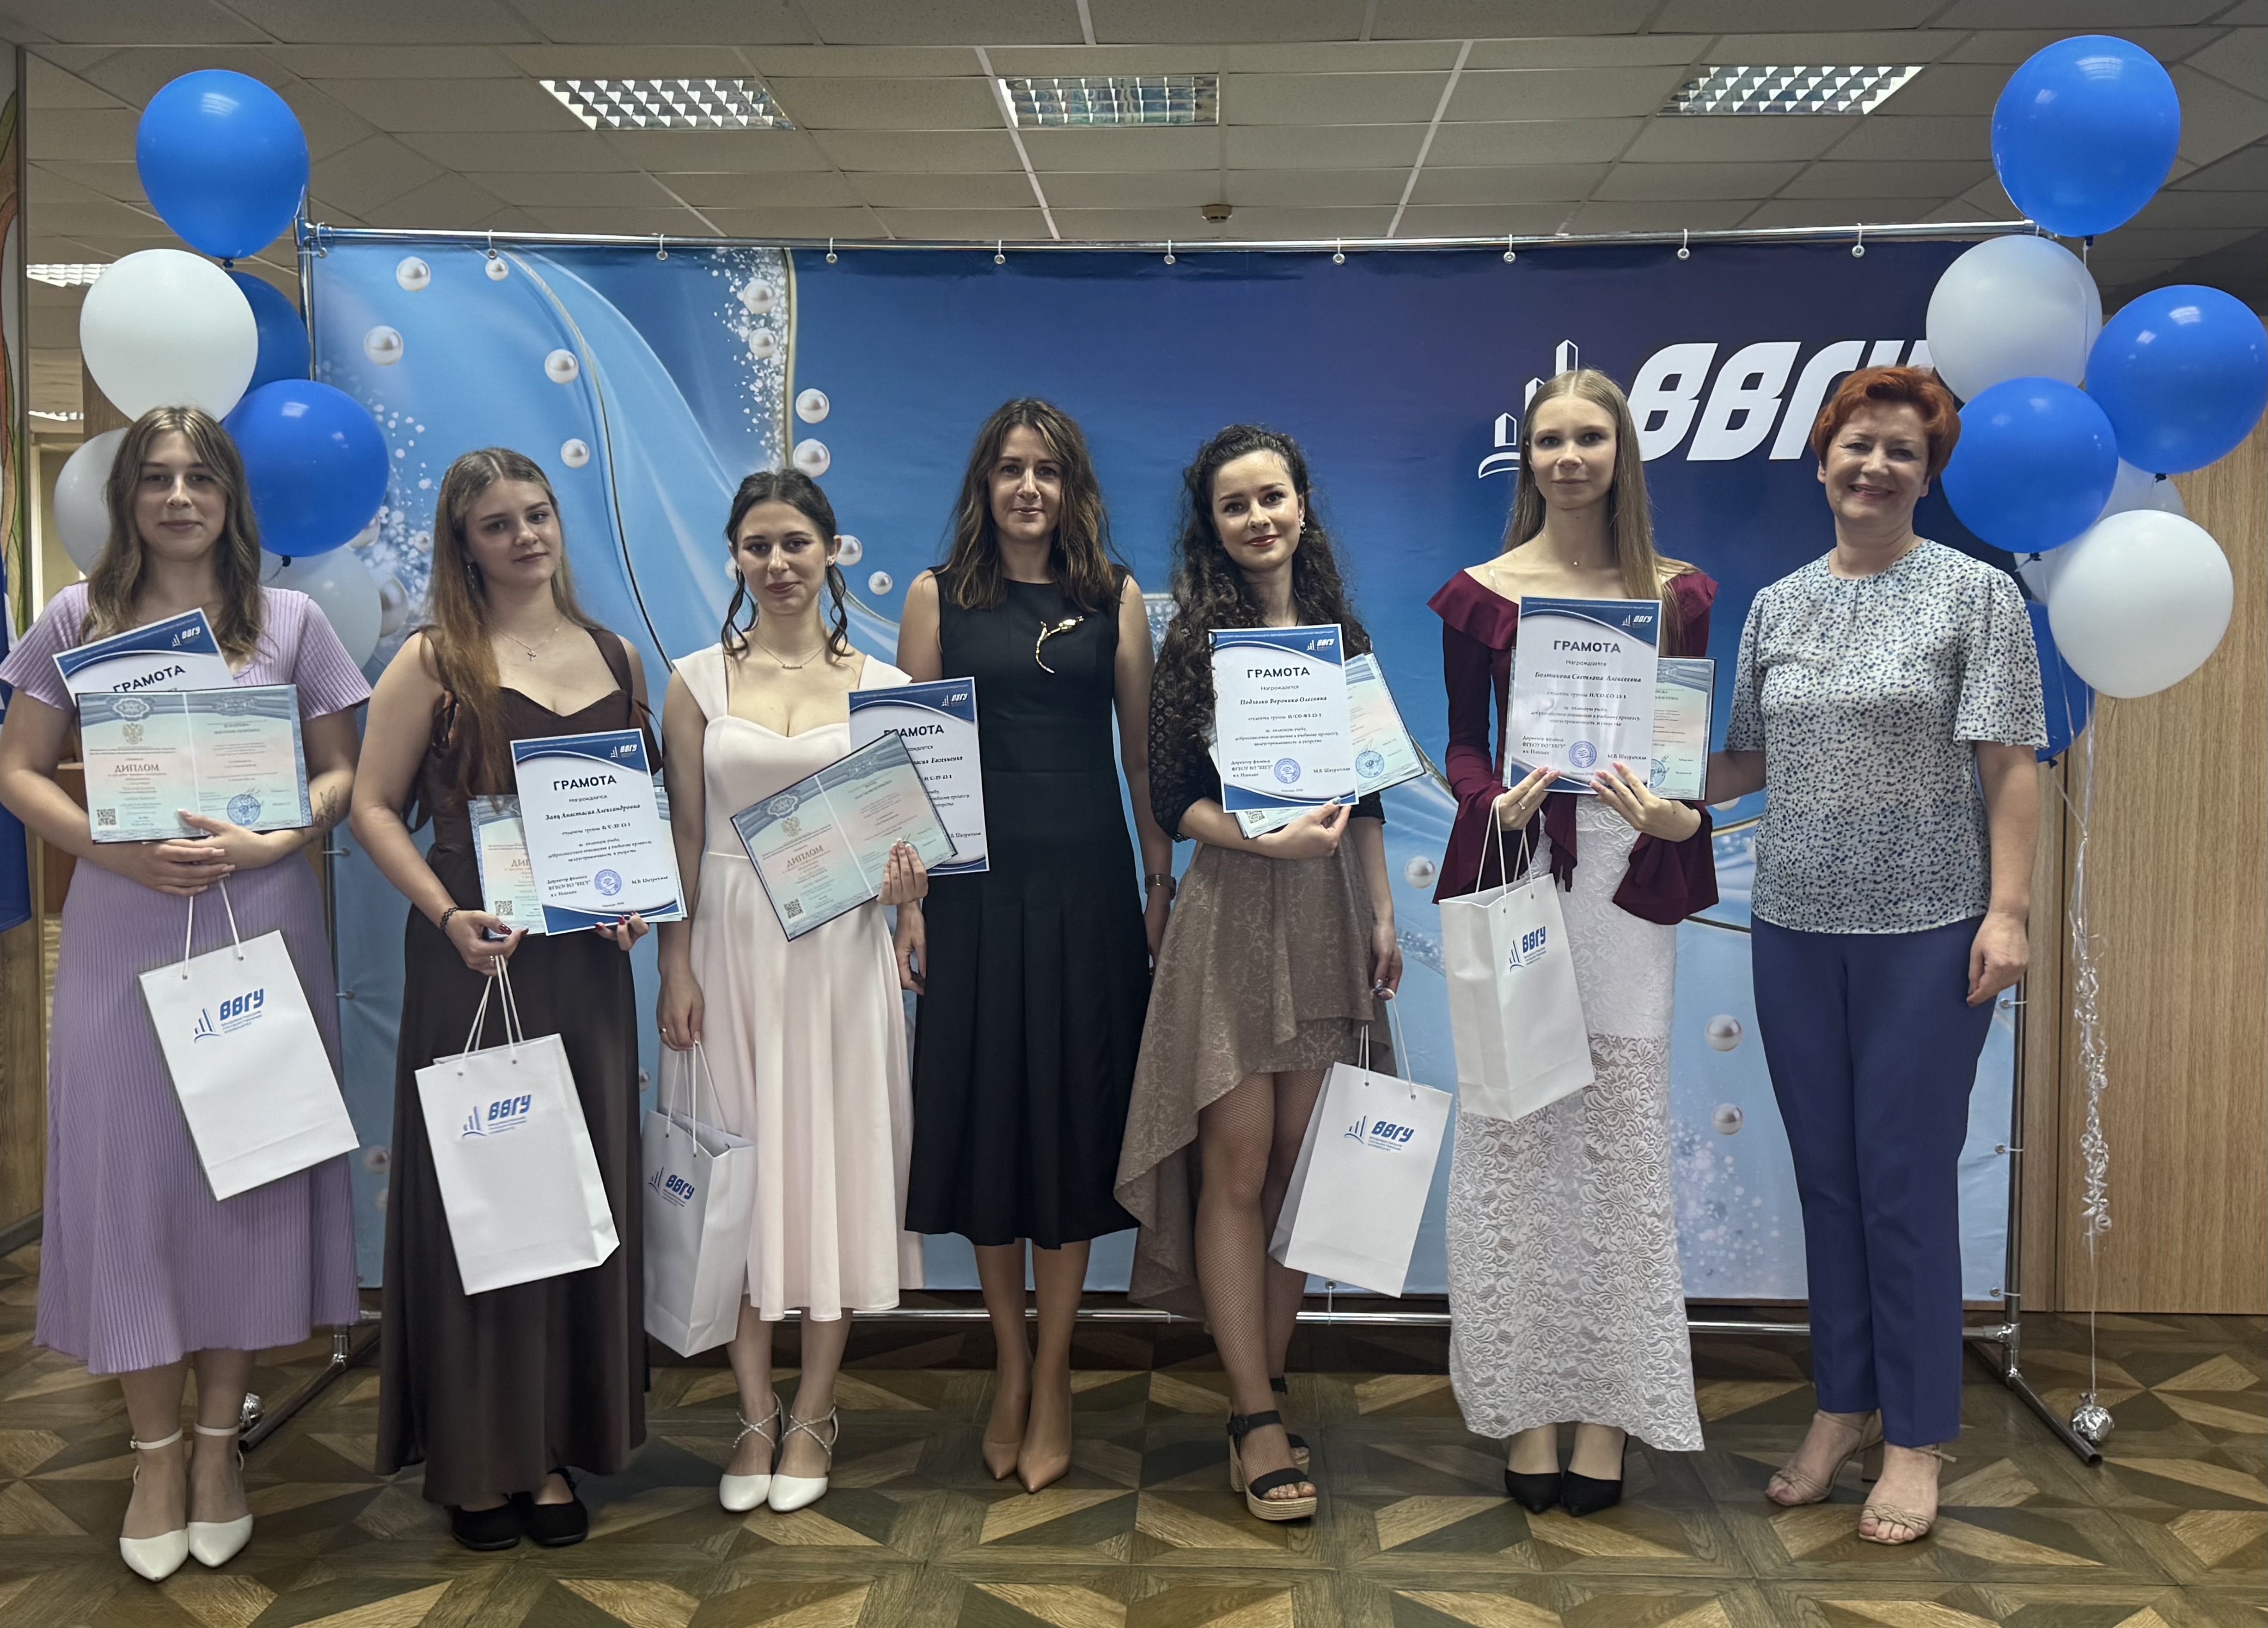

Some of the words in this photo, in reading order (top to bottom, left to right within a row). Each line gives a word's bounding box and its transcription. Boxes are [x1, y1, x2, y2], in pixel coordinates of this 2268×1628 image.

[1629, 340, 1935, 461] ВВГ
[1553, 640, 1621, 653] ГРАМОТА
[113, 664, 186, 692] ГРАМОТА
[1247, 667, 1310, 678] ГРАМОТА
[115, 764, 159, 773] ДИПЛОМ
[553, 775, 617, 791] ГРАМОТА
[787, 845, 824, 868] ДИПЛОМ
[1522, 926, 1546, 953] ВВГУ
[220, 988, 264, 1021] ВВГУ
[488, 1094, 532, 1121] ВВГУ
[1371, 1120, 1414, 1143] ВВГУ
[665, 1174, 695, 1200] ВВГУ
